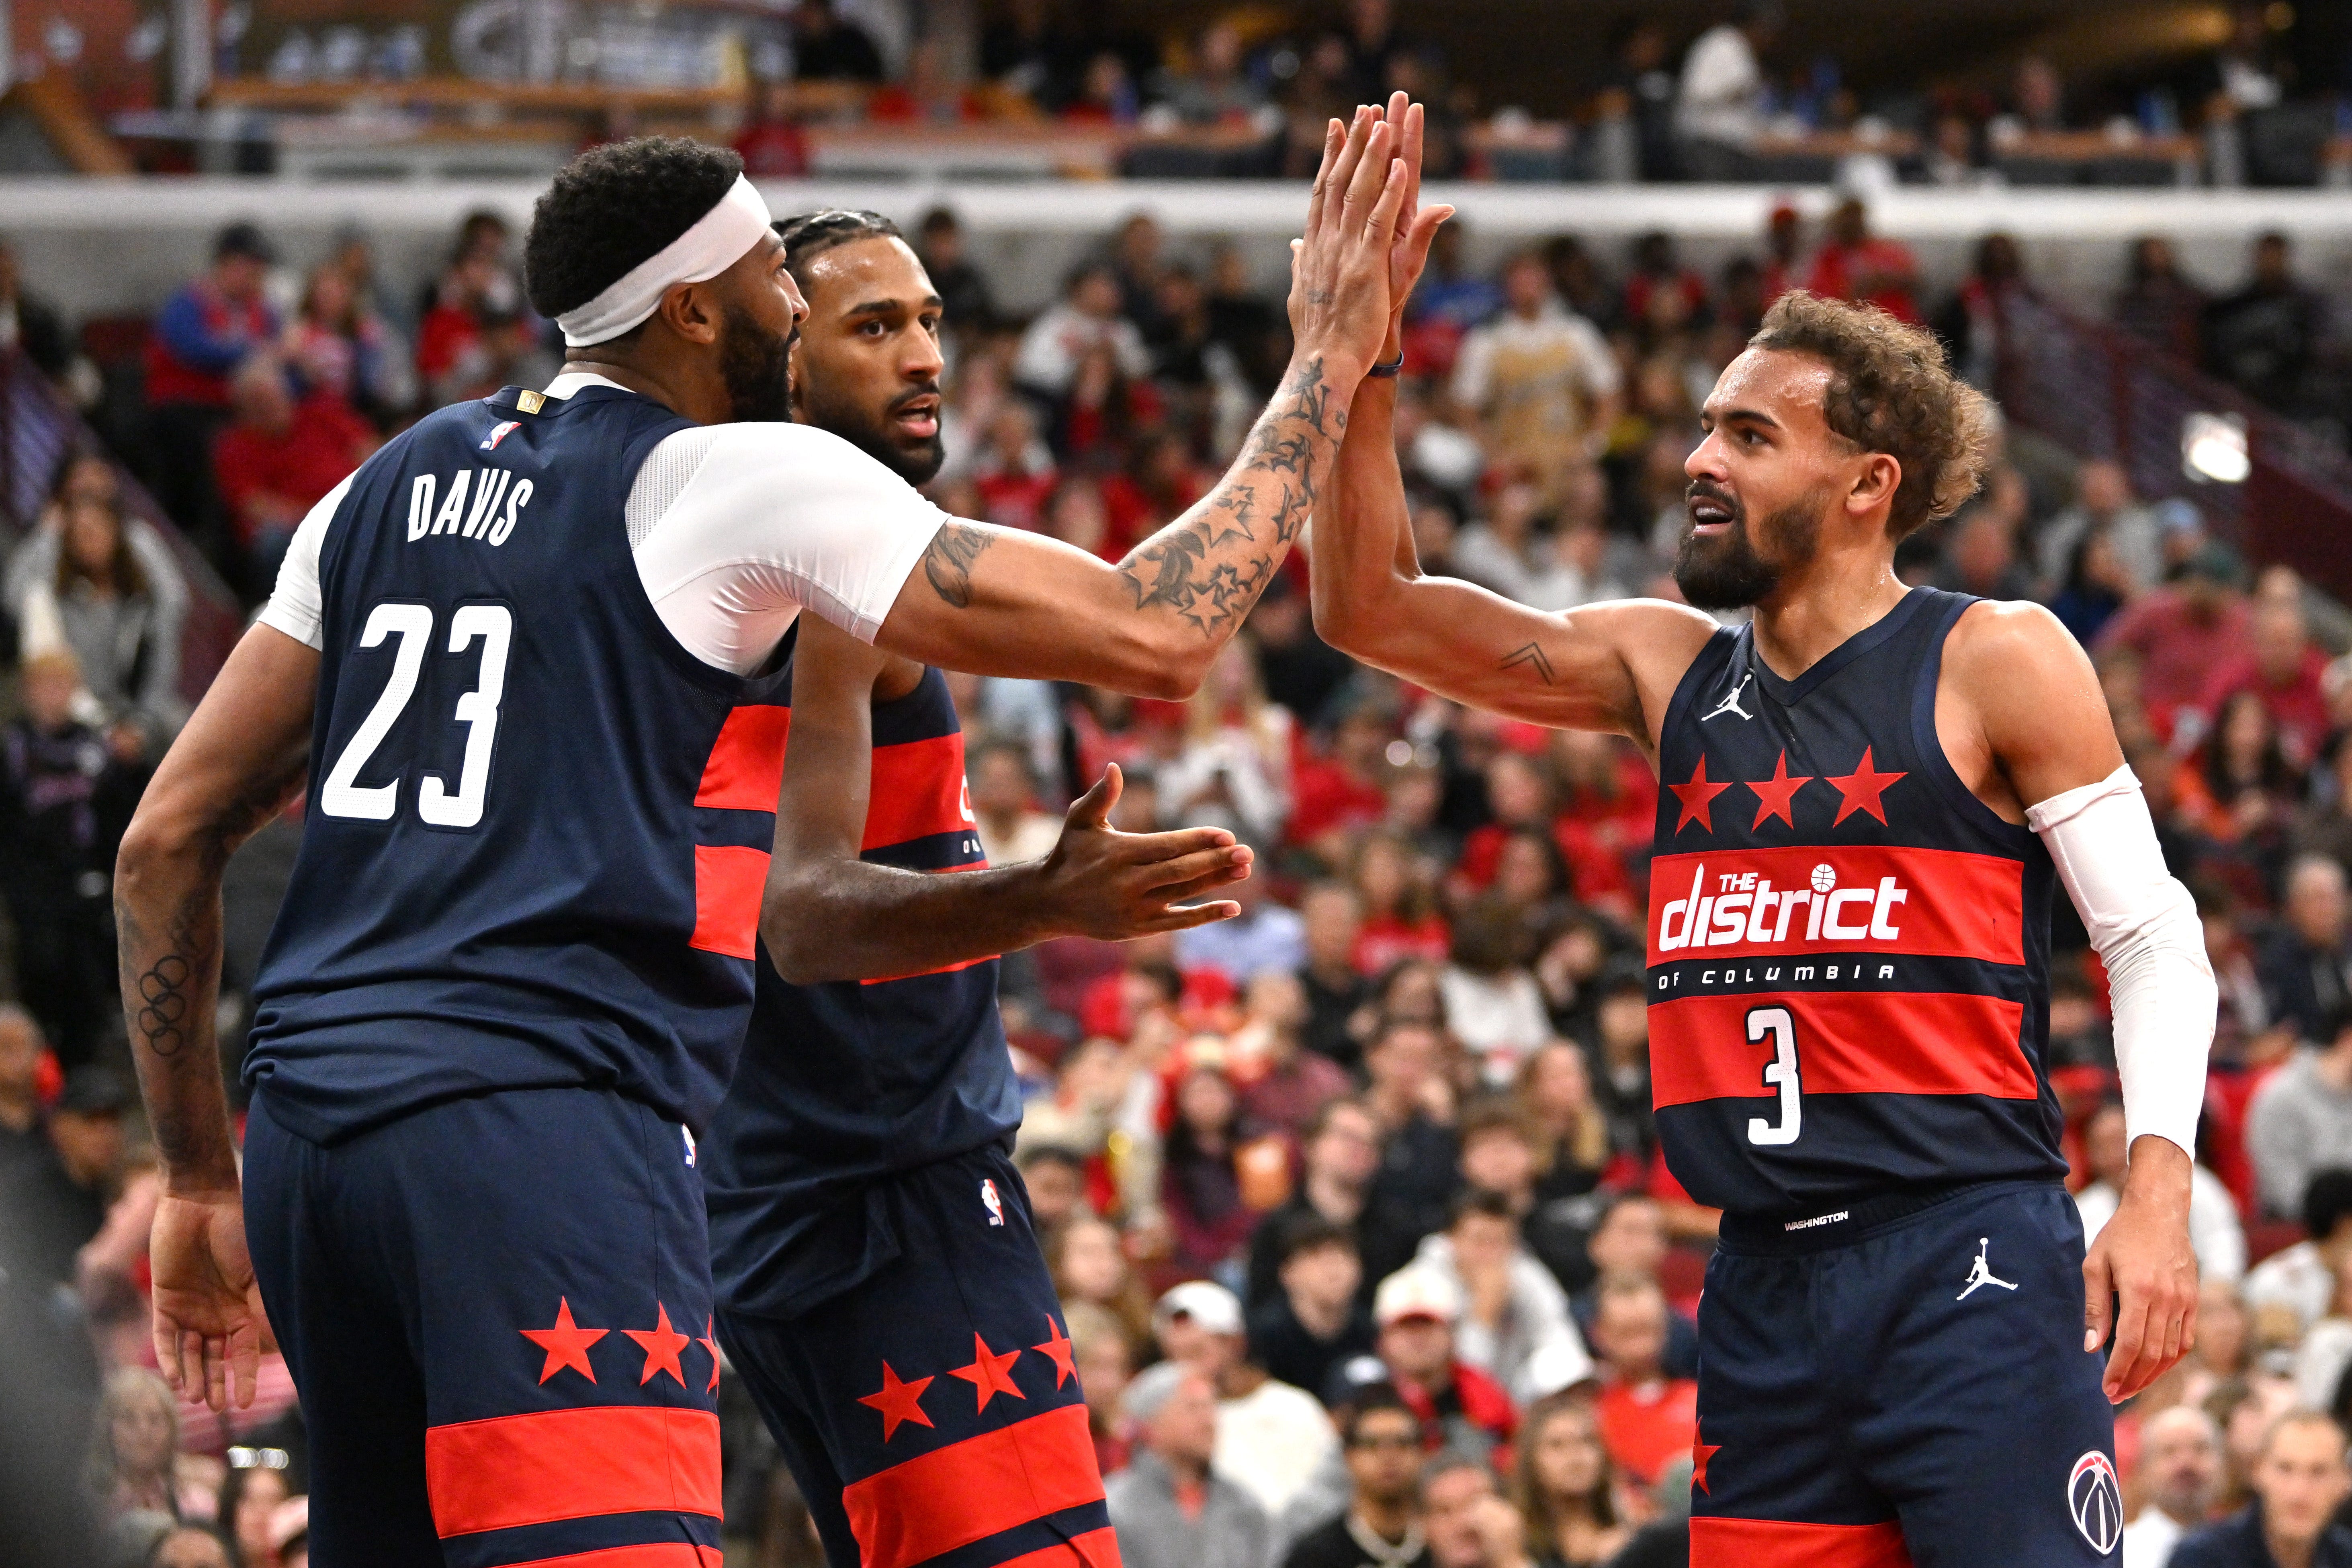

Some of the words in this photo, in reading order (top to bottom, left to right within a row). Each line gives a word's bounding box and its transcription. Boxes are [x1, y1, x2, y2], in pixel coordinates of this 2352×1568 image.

[408, 469, 533, 546] DAVIS
[321, 604, 512, 827] 23
[1659, 863, 1908, 952] district
[1719, 872, 1758, 892] THE
[1659, 972, 1679, 989] OF
[1702, 965, 1894, 984] COLUMBIA
[1748, 1009, 1801, 1145] 3
[1785, 1211, 1848, 1231] WASHINGTON
